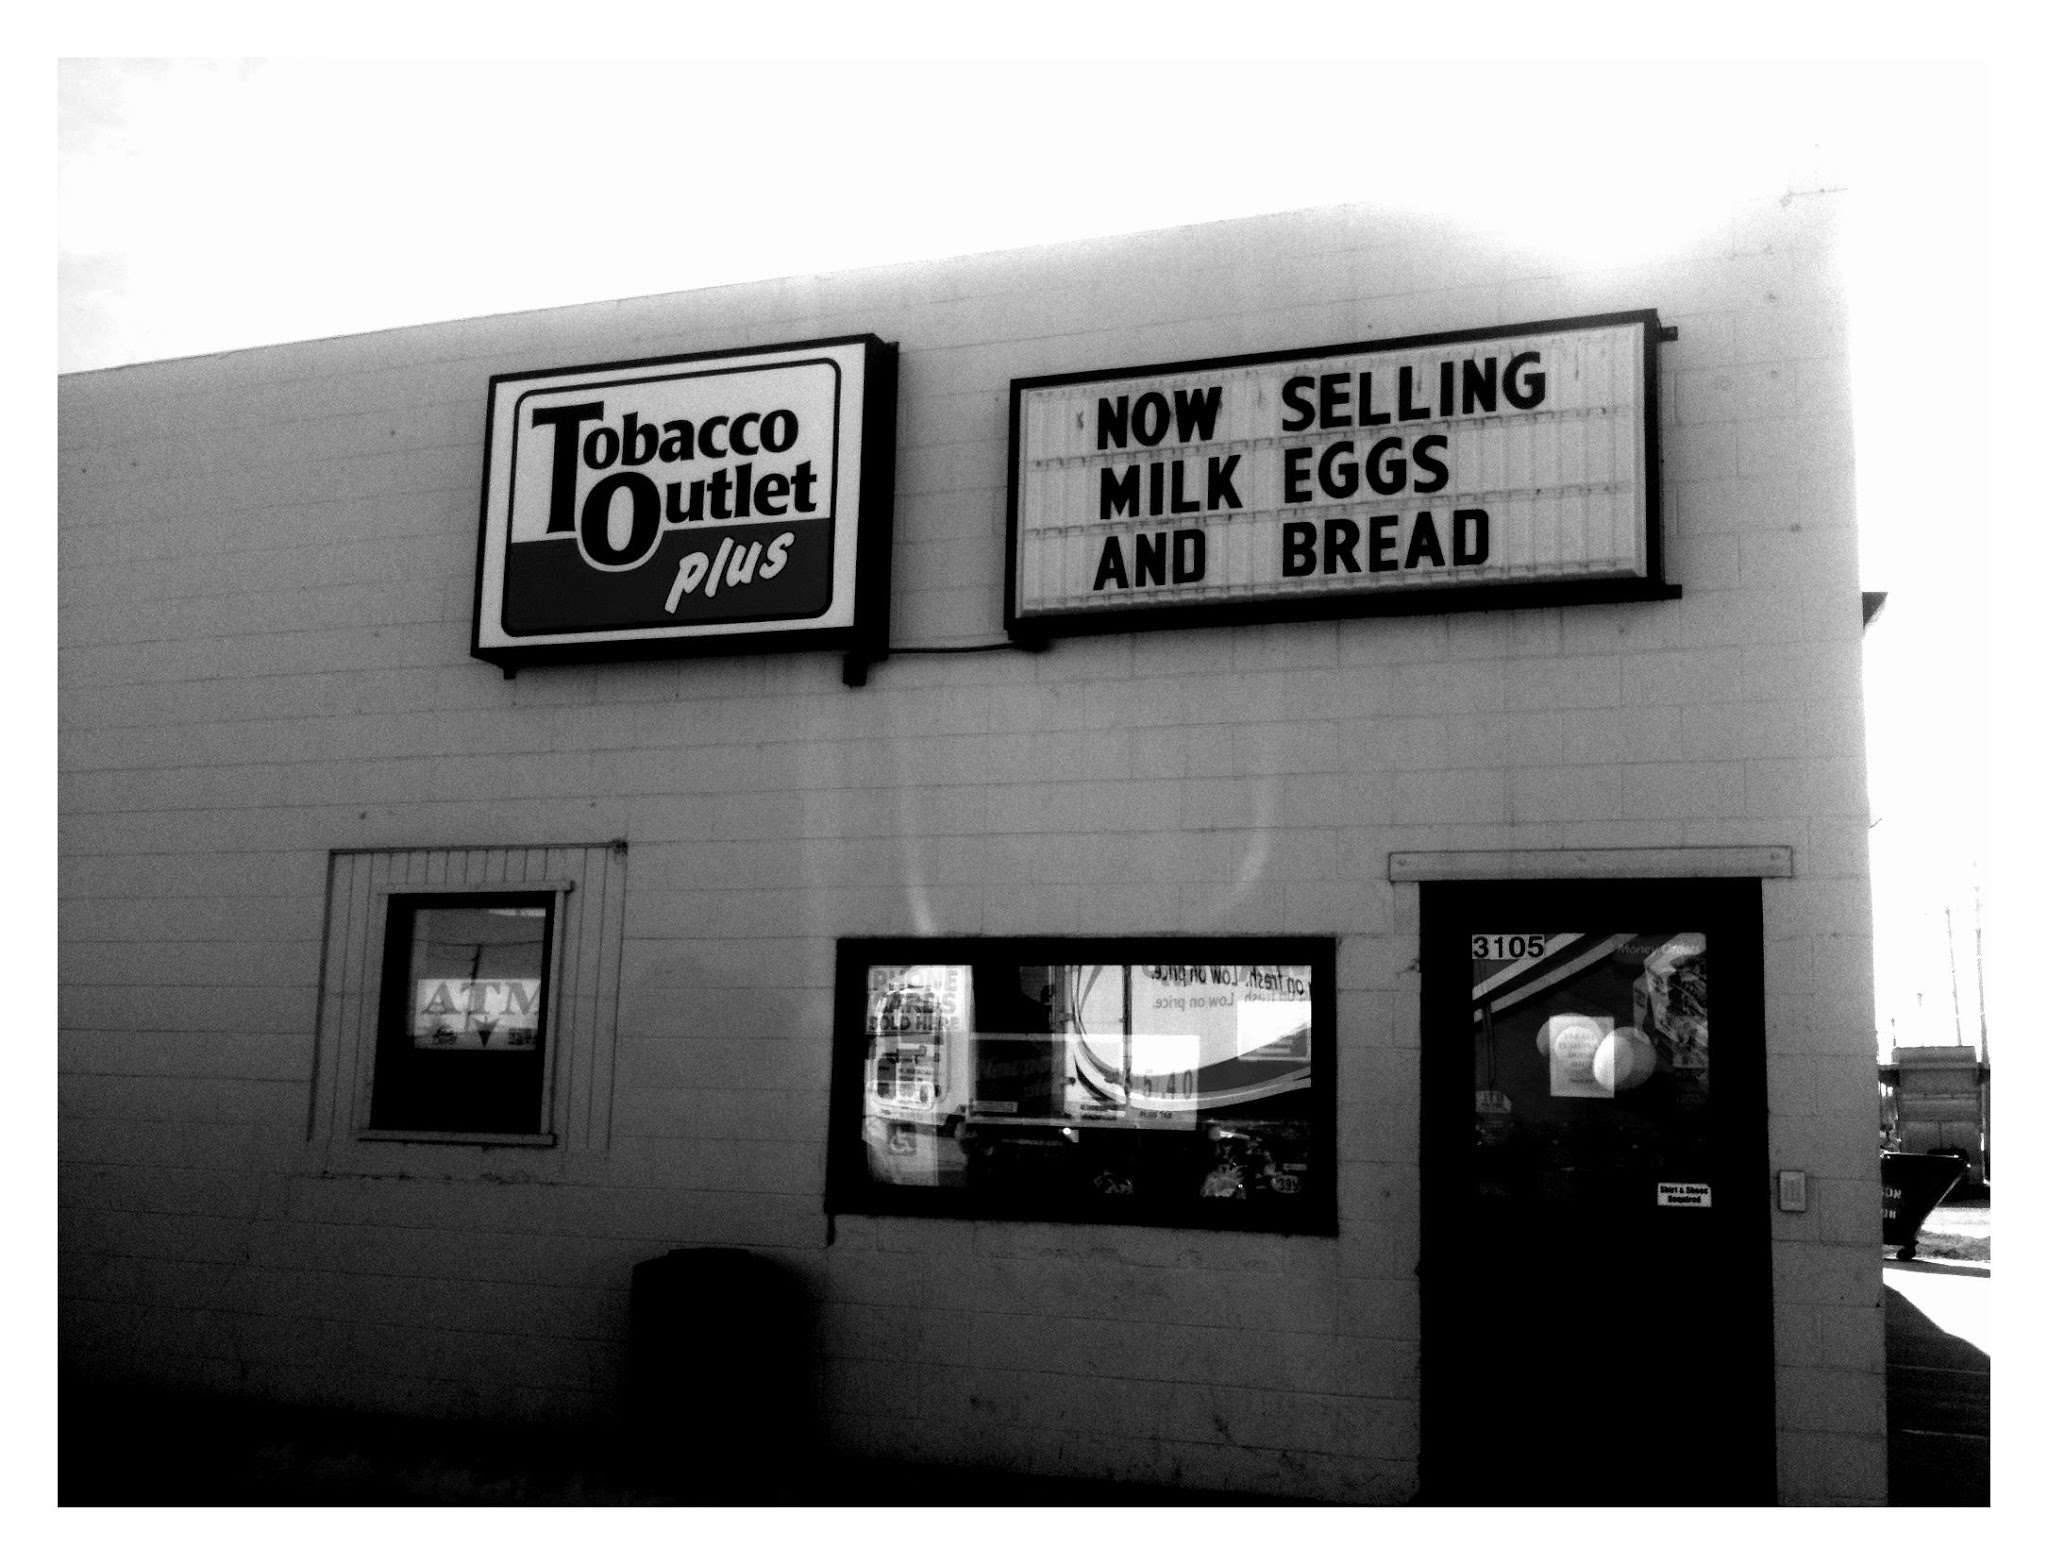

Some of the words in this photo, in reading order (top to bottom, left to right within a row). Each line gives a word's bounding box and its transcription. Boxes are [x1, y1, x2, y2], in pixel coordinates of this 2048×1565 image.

[1097, 386, 1222, 450] NOW
[1282, 352, 1546, 432] SELLING
[531, 401, 799, 534] Tobacco
[1099, 454, 1243, 520] MILK
[1283, 435, 1450, 504] EGGS
[581, 460, 818, 566] Outlet
[1093, 528, 1207, 591] AND
[1282, 508, 1490, 578] BREAD
[664, 531, 795, 614] plus
[1473, 935, 1544, 958] 3105
[422, 981, 541, 1016] ATM
[868, 1015, 912, 1031] SOLD
[1660, 1185, 1678, 1194] Shirt
[1686, 1186, 1708, 1195] Shoes
[1668, 1195, 1701, 1204] Required
